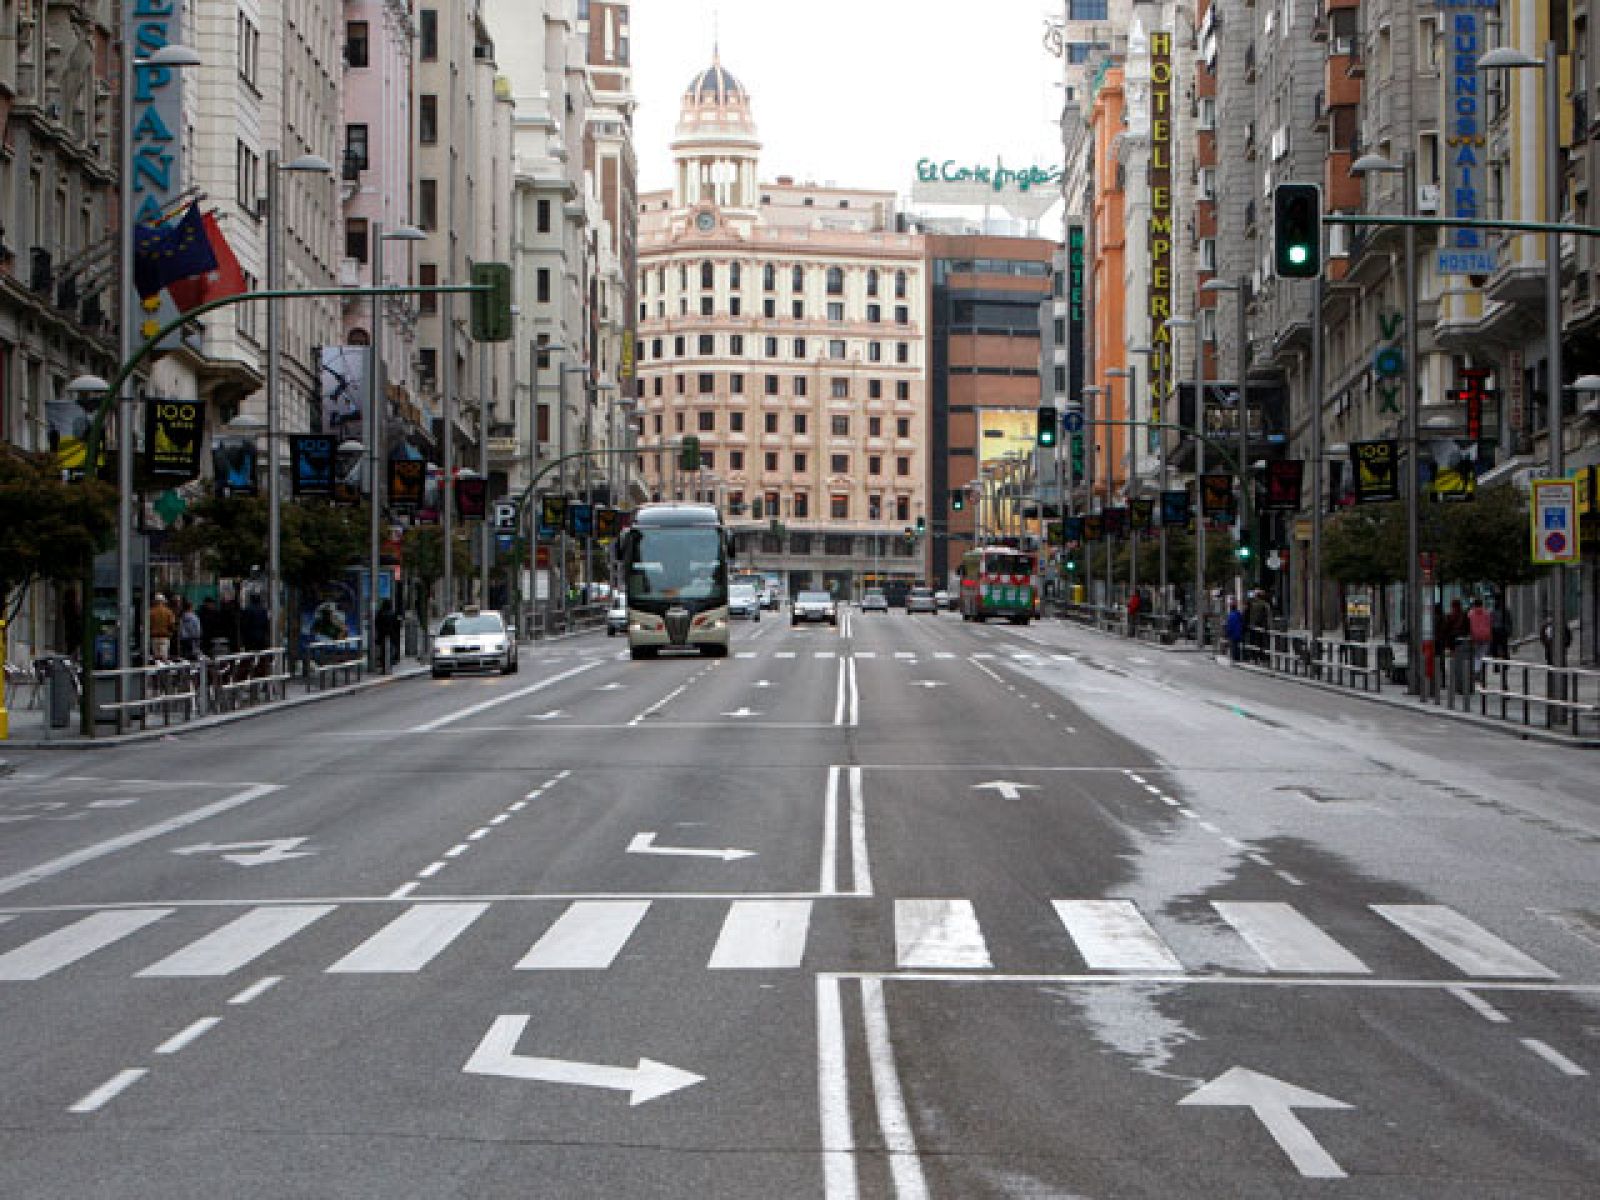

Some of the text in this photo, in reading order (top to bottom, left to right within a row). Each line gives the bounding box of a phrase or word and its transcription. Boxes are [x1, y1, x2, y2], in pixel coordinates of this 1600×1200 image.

[1151, 33, 1171, 169] HOTEL
[1454, 14, 1476, 136] BUENOS
[916, 158, 938, 182] El
[1071, 230, 1084, 320] HOTEL
[1439, 253, 1495, 273] HOSTAL
[156, 404, 196, 421] 100
